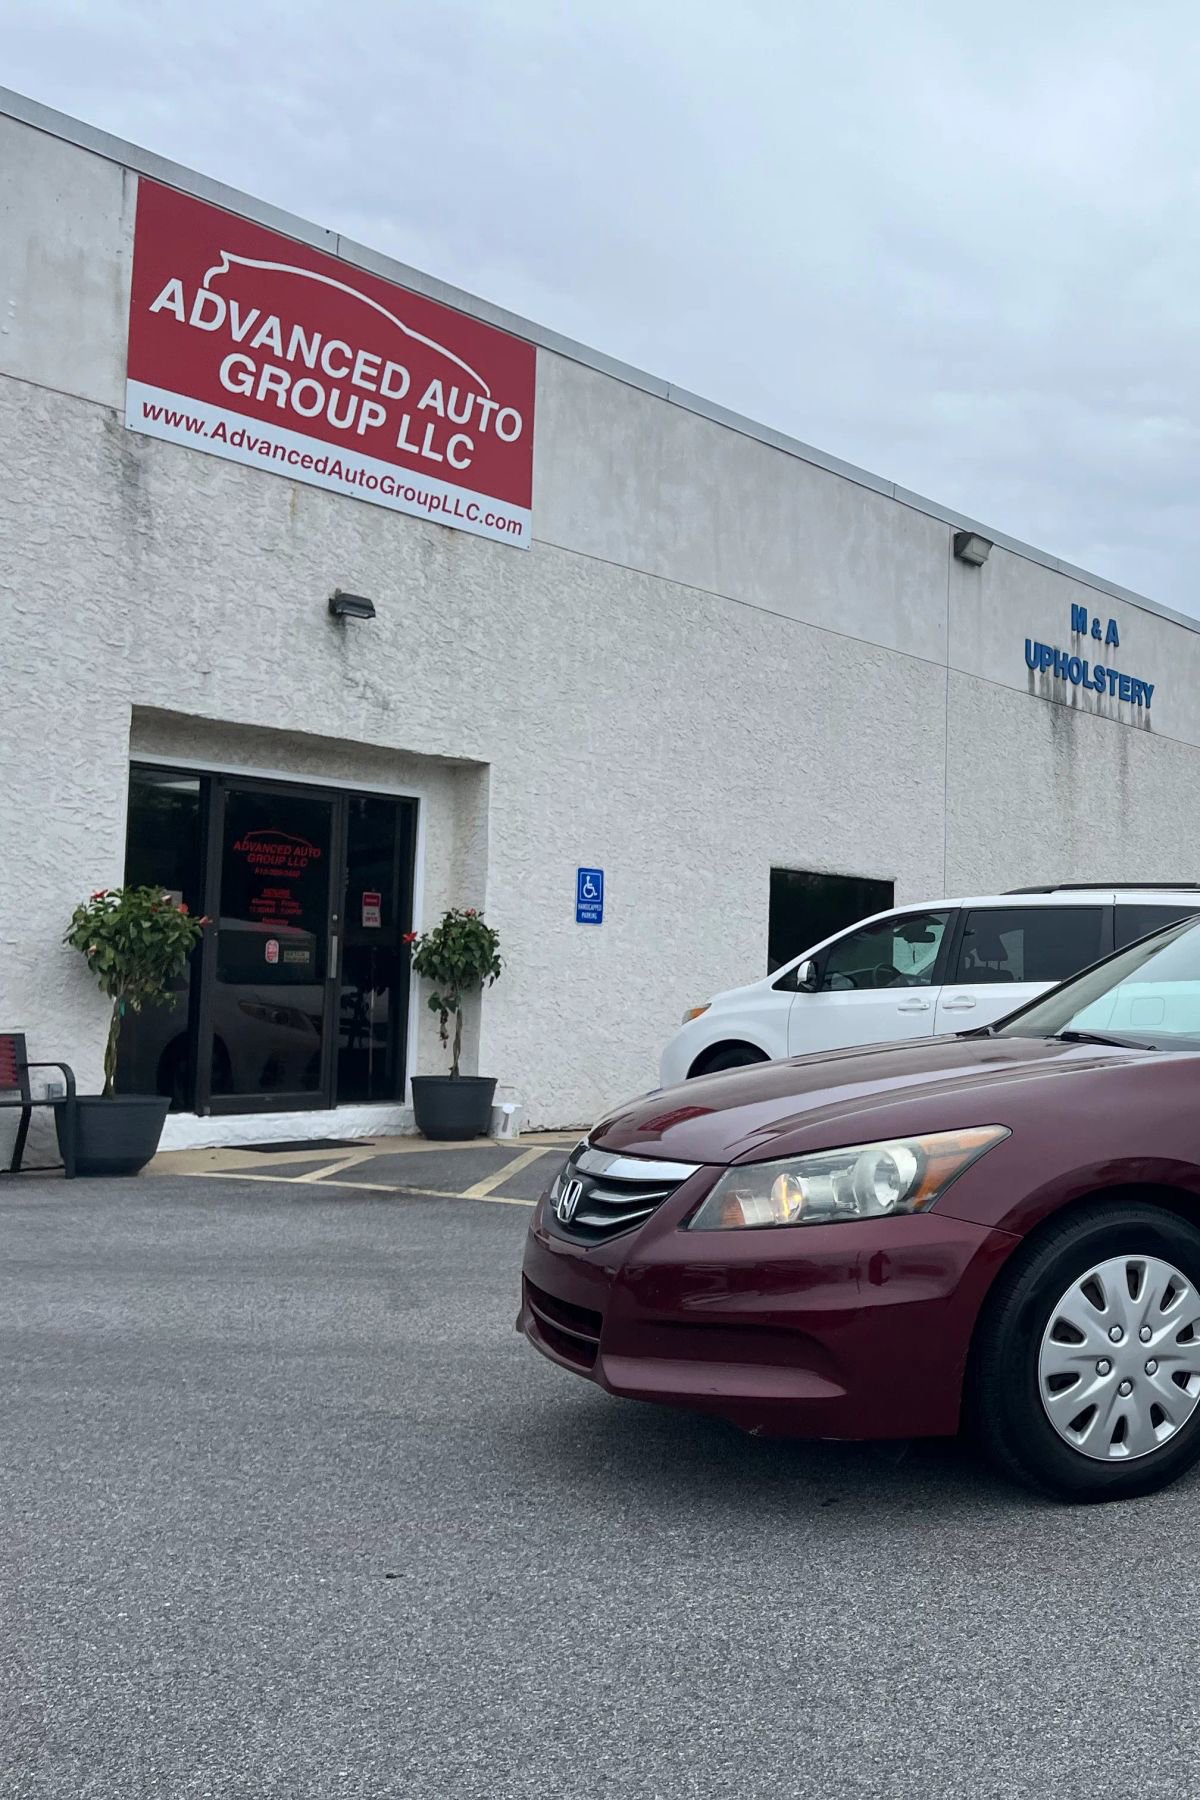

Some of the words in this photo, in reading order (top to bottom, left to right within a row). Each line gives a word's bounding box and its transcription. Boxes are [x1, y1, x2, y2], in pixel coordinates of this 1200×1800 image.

[149, 278, 411, 400] ADVANCED
[417, 379, 523, 442] AUTO
[219, 352, 387, 436] GROUP
[396, 413, 475, 470] LLC
[142, 401, 523, 537] www.AdvancedAutoGroupLLC.com
[1071, 603, 1088, 635] M
[1091, 617, 1103, 641] &
[1105, 618, 1120, 647] A
[1025, 638, 1155, 709] UPHOLSTERY
[234, 841, 292, 854] ADVANCED
[293, 847, 321, 857] AUTO
[248, 854, 286, 865] GROUP
[287, 857, 308, 867] LLC
